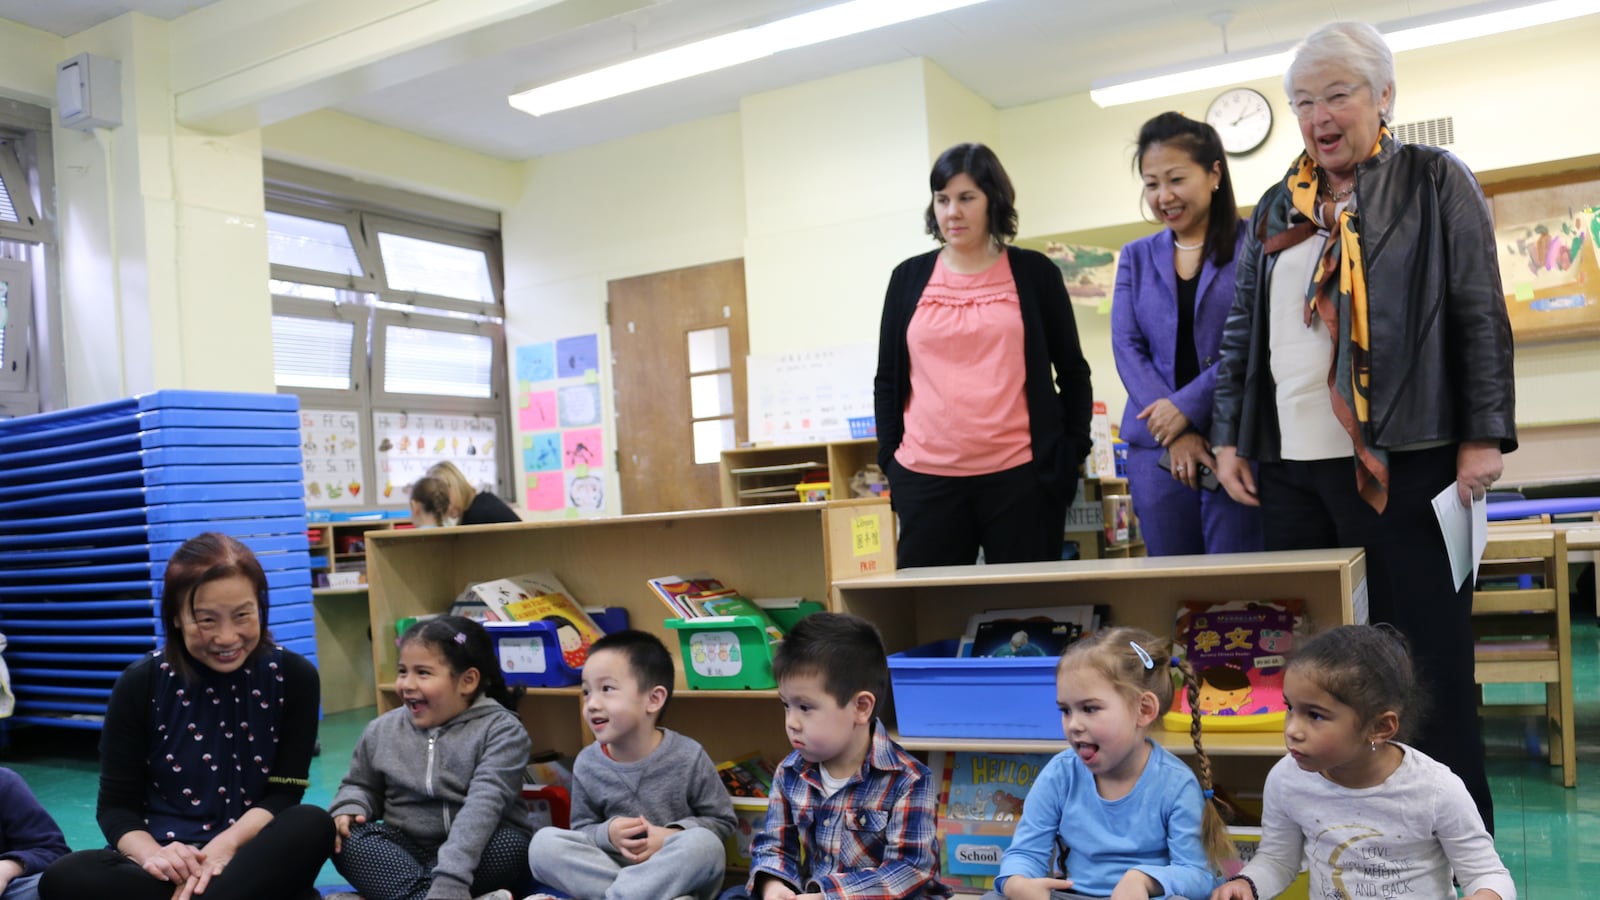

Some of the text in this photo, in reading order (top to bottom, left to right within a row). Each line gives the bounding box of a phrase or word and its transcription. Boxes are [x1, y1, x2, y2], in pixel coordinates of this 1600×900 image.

[340, 415, 356, 434] Gg
[1066, 506, 1104, 526] NTER
[1194, 627, 1253, 653] 华文
[1268, 639, 1276, 650] 2
[960, 850, 998, 862] School
[1361, 846, 1392, 860] LOVE
[1364, 867, 1401, 880] MOON
[1355, 879, 1415, 899] AND BACK
